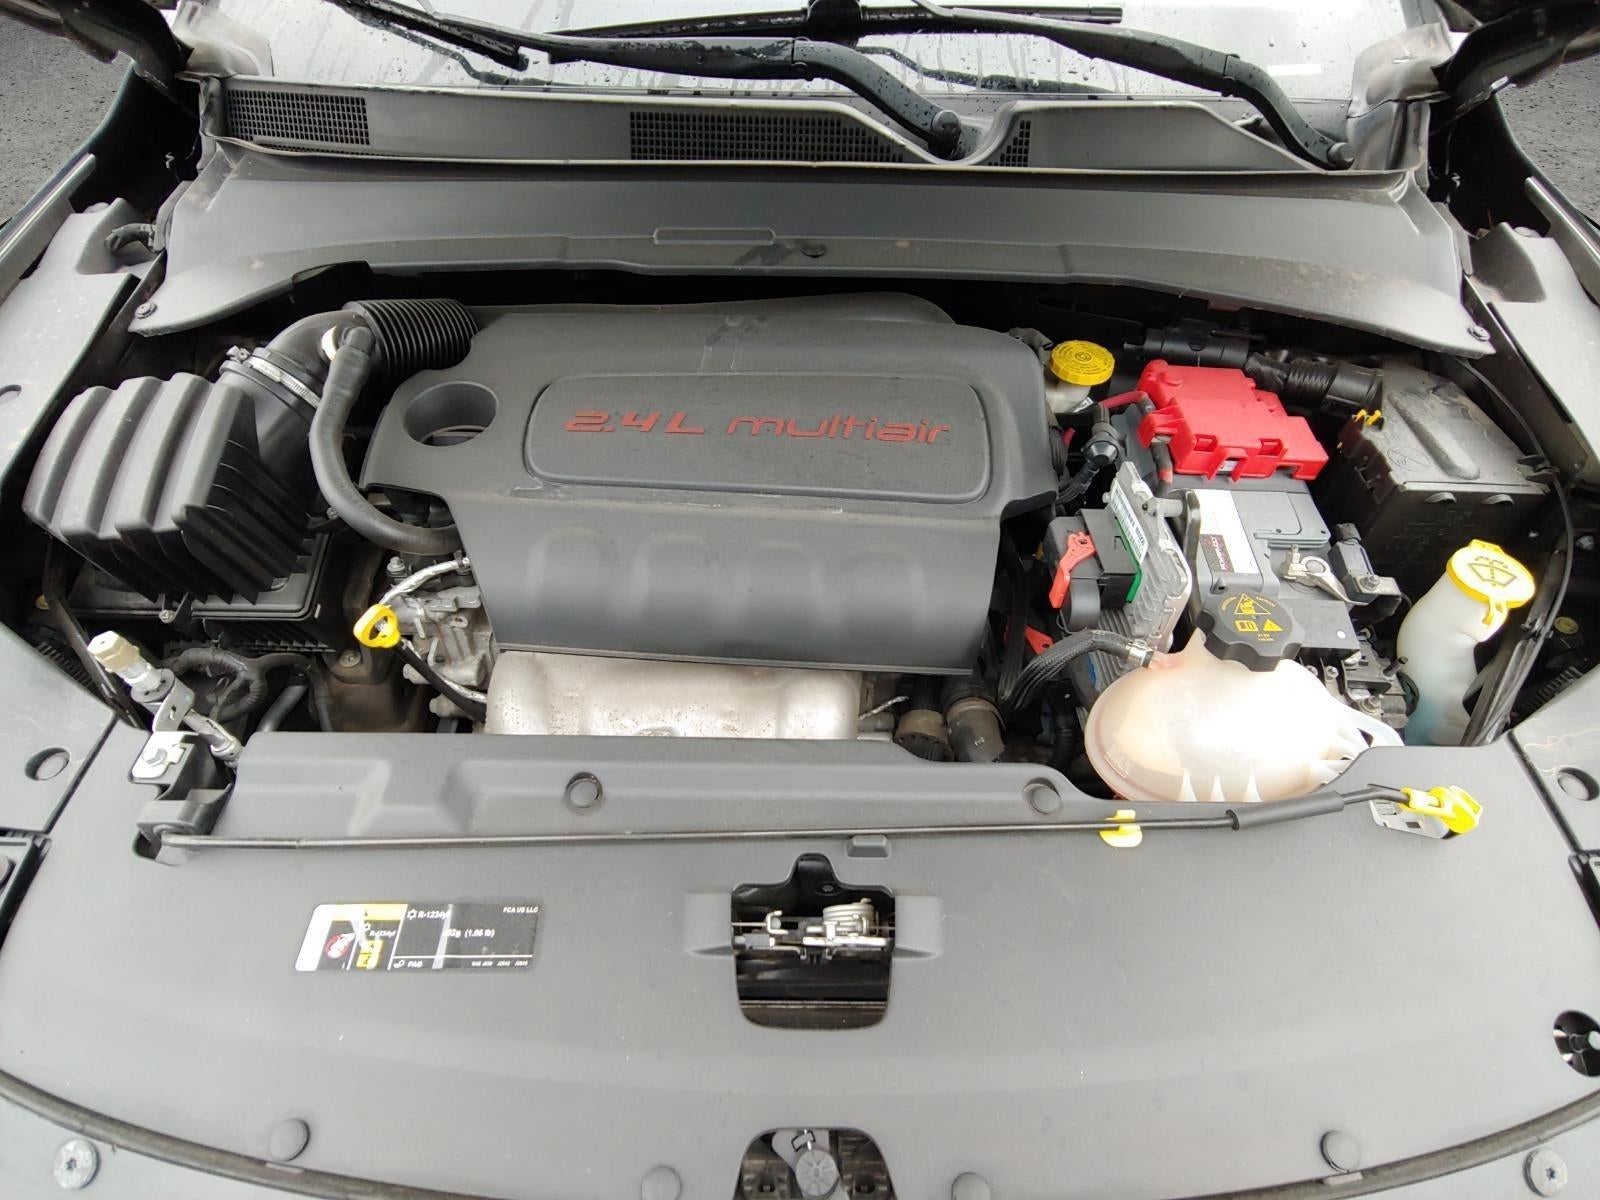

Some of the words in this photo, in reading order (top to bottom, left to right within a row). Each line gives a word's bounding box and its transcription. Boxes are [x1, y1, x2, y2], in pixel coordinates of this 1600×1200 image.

[564, 410, 705, 434] 2.4L
[727, 413, 951, 444] multiair
[503, 906, 516, 914] FCA
